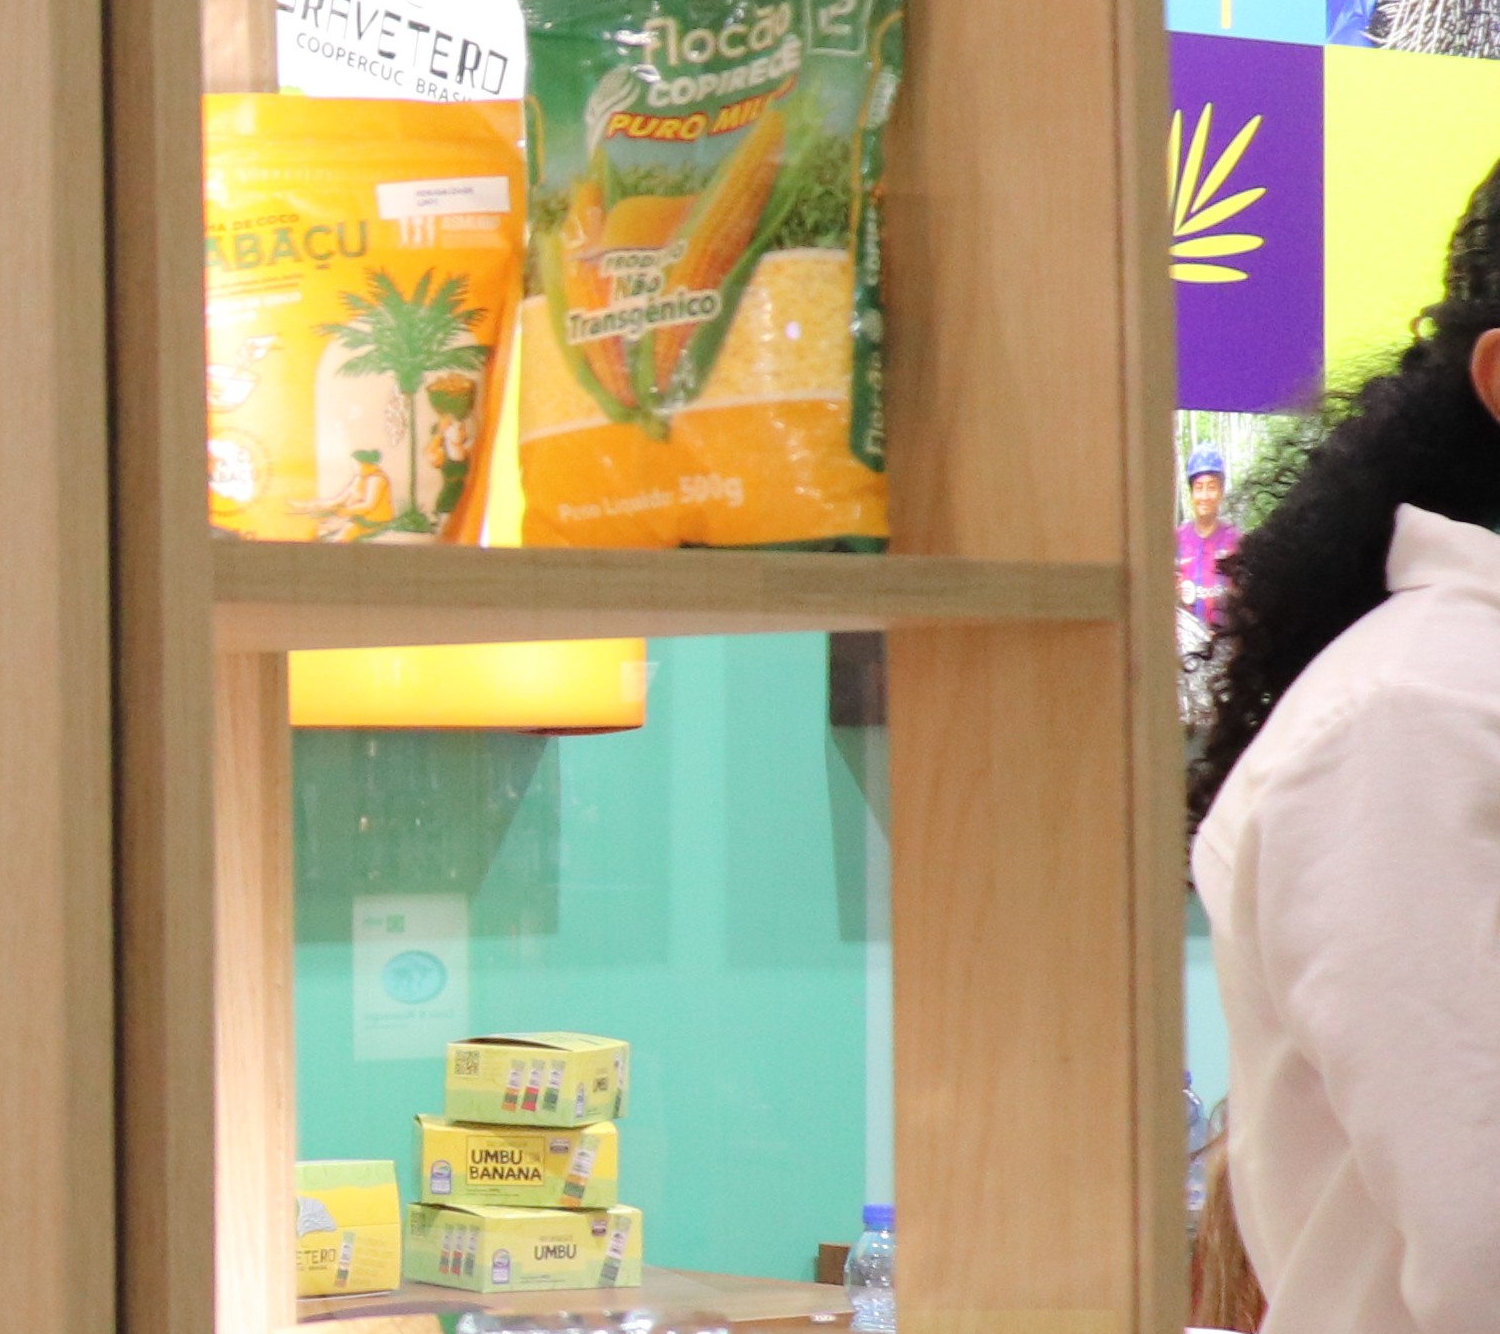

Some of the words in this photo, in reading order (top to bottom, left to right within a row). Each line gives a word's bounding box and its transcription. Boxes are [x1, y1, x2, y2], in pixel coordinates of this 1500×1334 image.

[296, 31, 406, 87] COOPERCUC
[603, 110, 709, 143] PURO
[206, 219, 370, 271] ABAÇU
[567, 287, 721, 342] Transgênico
[469, 1166, 543, 1181] BANANA
[471, 1148, 523, 1166] UMBU
[534, 1243, 578, 1261] UMBU
